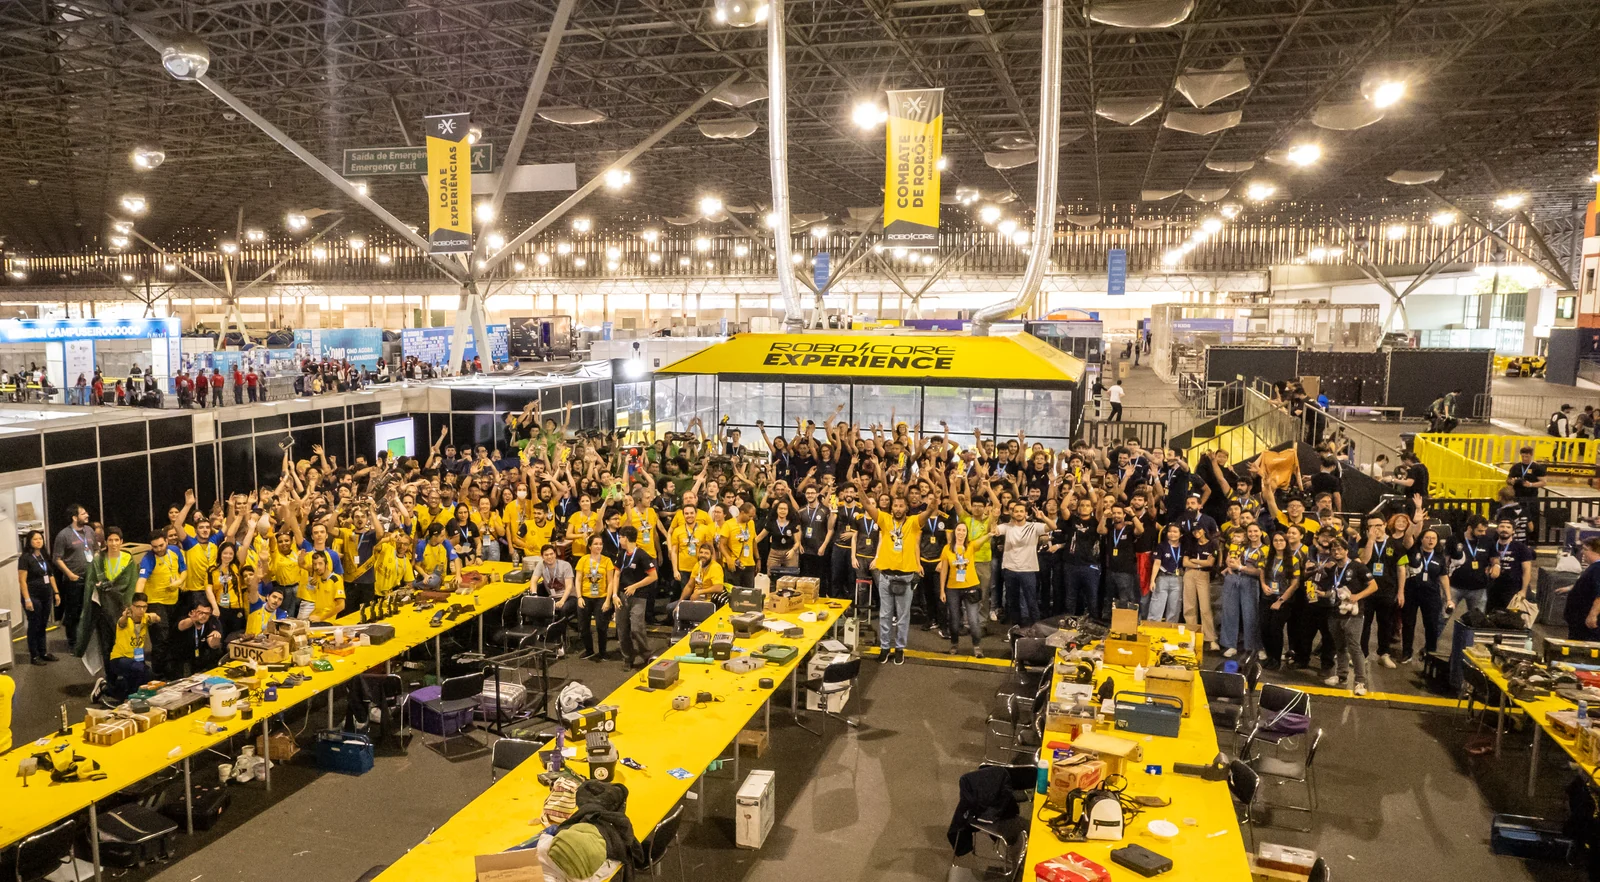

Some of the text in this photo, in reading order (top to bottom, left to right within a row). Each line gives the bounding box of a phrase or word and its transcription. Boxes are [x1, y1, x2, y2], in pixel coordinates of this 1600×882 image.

[351, 150, 427, 161] Saída de Emergên
[351, 162, 416, 173] Emergency Exit
[897, 135, 911, 208] COMBATE
[911, 135, 926, 208] DE ROBÔS
[440, 178, 448, 208] LOJA
[449, 146, 459, 226] EXPERIÊNCIAS
[763, 353, 953, 370] EXPERIENCE
[233, 646, 264, 663] DUCK
